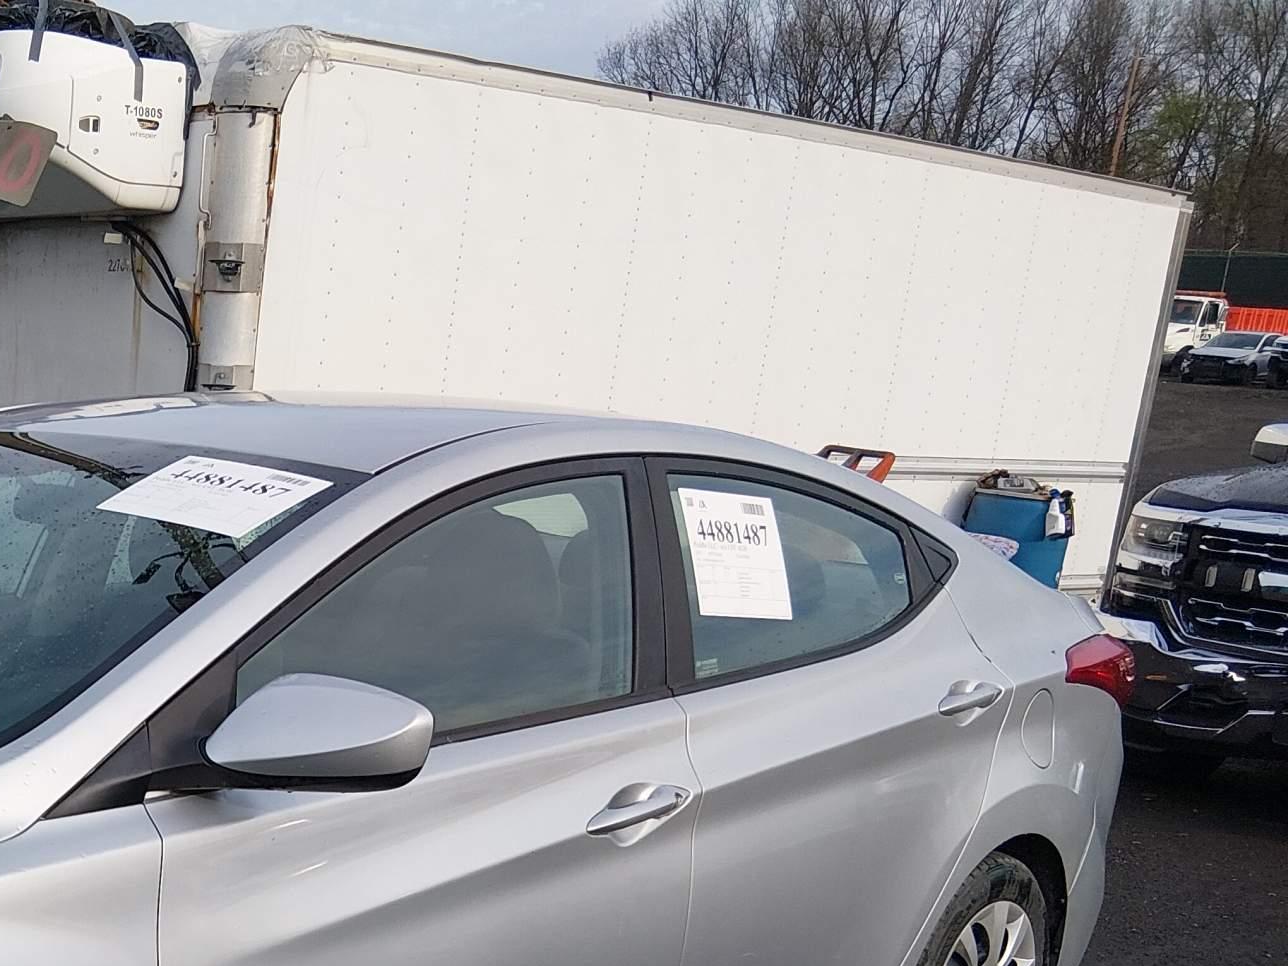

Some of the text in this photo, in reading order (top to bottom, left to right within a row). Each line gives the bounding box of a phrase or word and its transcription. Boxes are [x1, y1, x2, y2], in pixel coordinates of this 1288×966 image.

[124, 104, 164, 119] T-1080S
[170, 468, 292, 498] 44881487
[697, 518, 768, 547] 44881487
